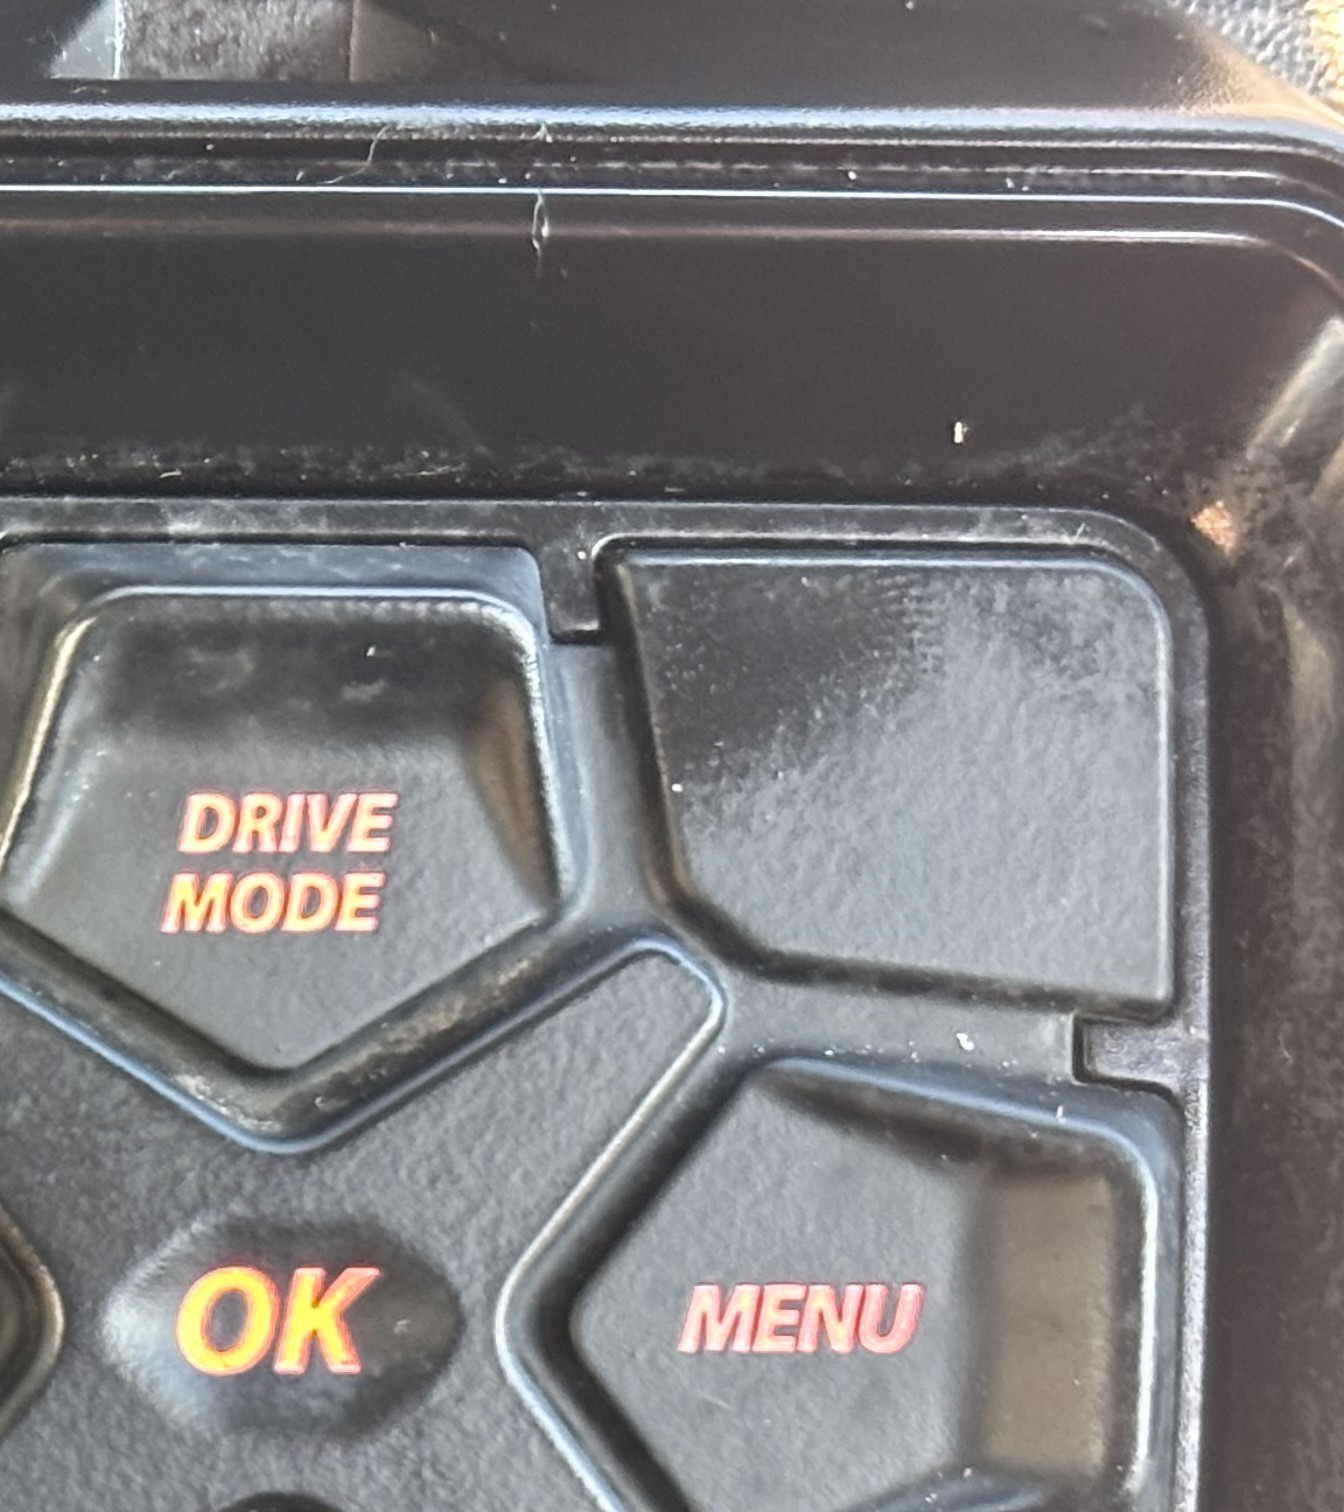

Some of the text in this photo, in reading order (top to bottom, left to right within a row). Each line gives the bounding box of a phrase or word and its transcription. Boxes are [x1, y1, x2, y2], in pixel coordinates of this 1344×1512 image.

[178, 791, 400, 854] DRIVE
[160, 870, 387, 934] MODE
[175, 1265, 382, 1376] OK
[676, 1282, 925, 1354] MENU
